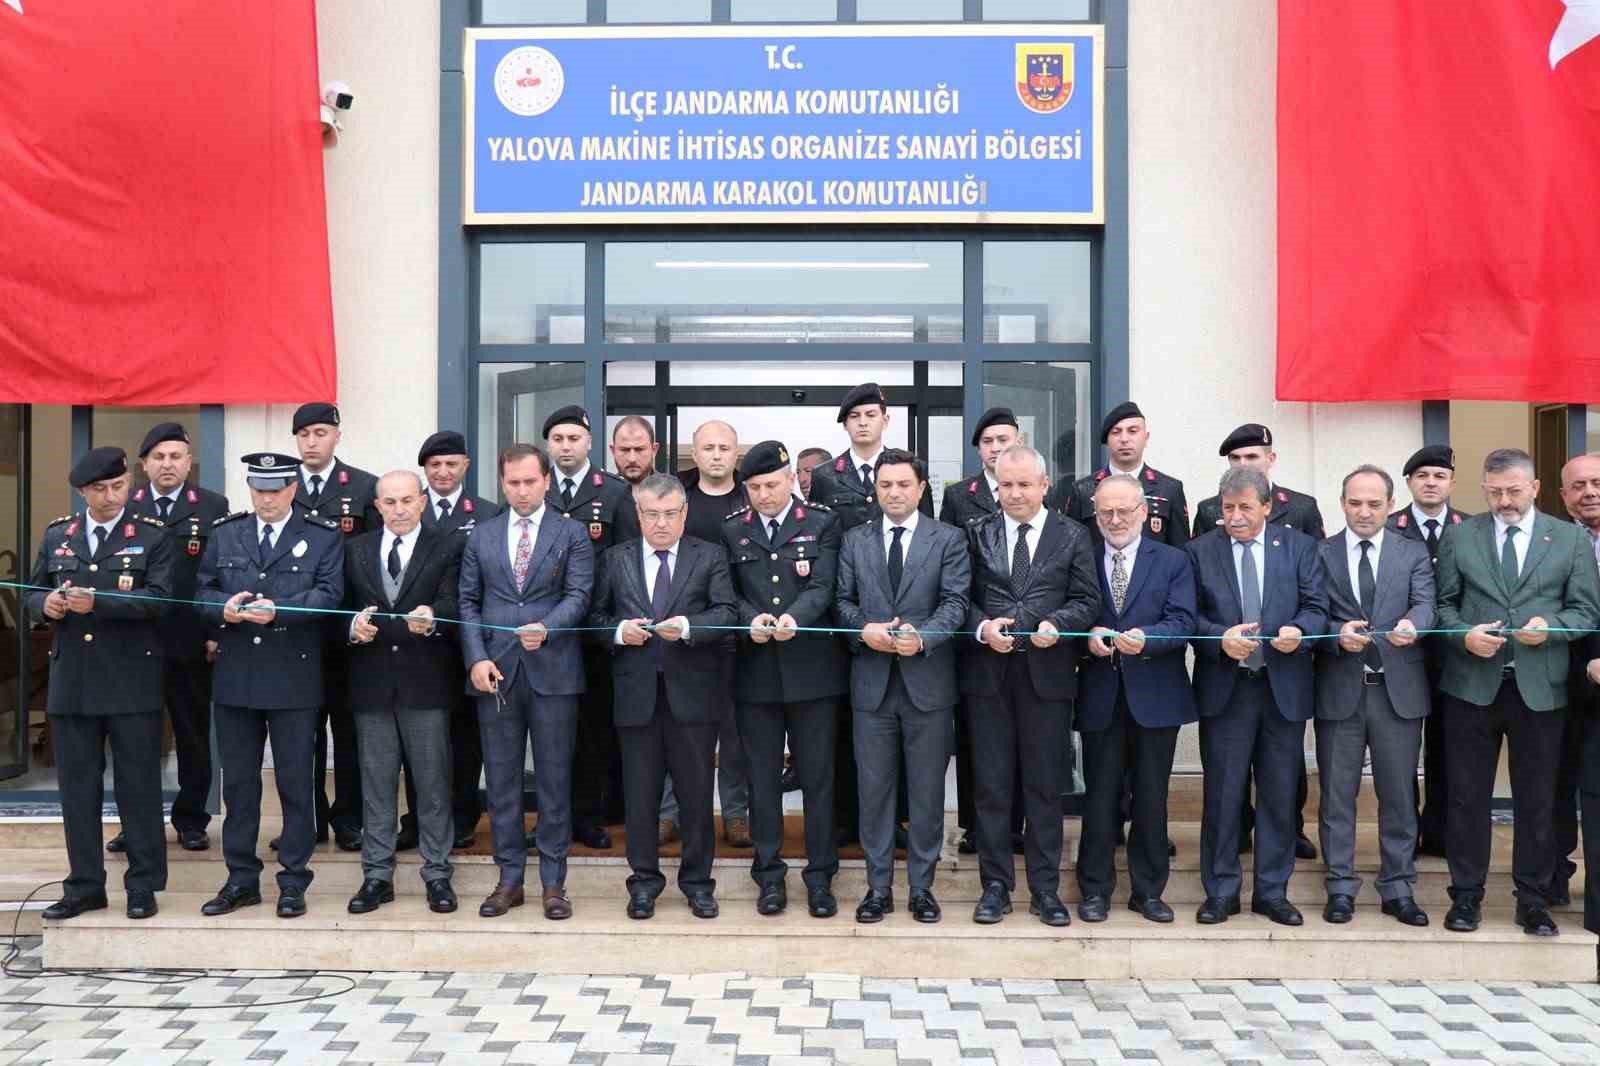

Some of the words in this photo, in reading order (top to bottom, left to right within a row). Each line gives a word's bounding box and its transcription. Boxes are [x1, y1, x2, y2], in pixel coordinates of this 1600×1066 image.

[764, 44, 803, 70] T.C.
[610, 84, 657, 122] İLÇE
[662, 90, 790, 116] JANDARMA
[795, 82, 959, 115] KOMUTANLIĞI
[488, 136, 575, 162] YALOVA
[580, 129, 671, 161] MAKİNE
[677, 129, 766, 160] İHTİSAS
[771, 128, 890, 160] ORGANİZE
[896, 128, 977, 160] SANAYİ
[984, 128, 1082, 160] BÖLGESİ
[580, 180, 707, 207] JANDARMA
[712, 180, 818, 206] KARAKOL
